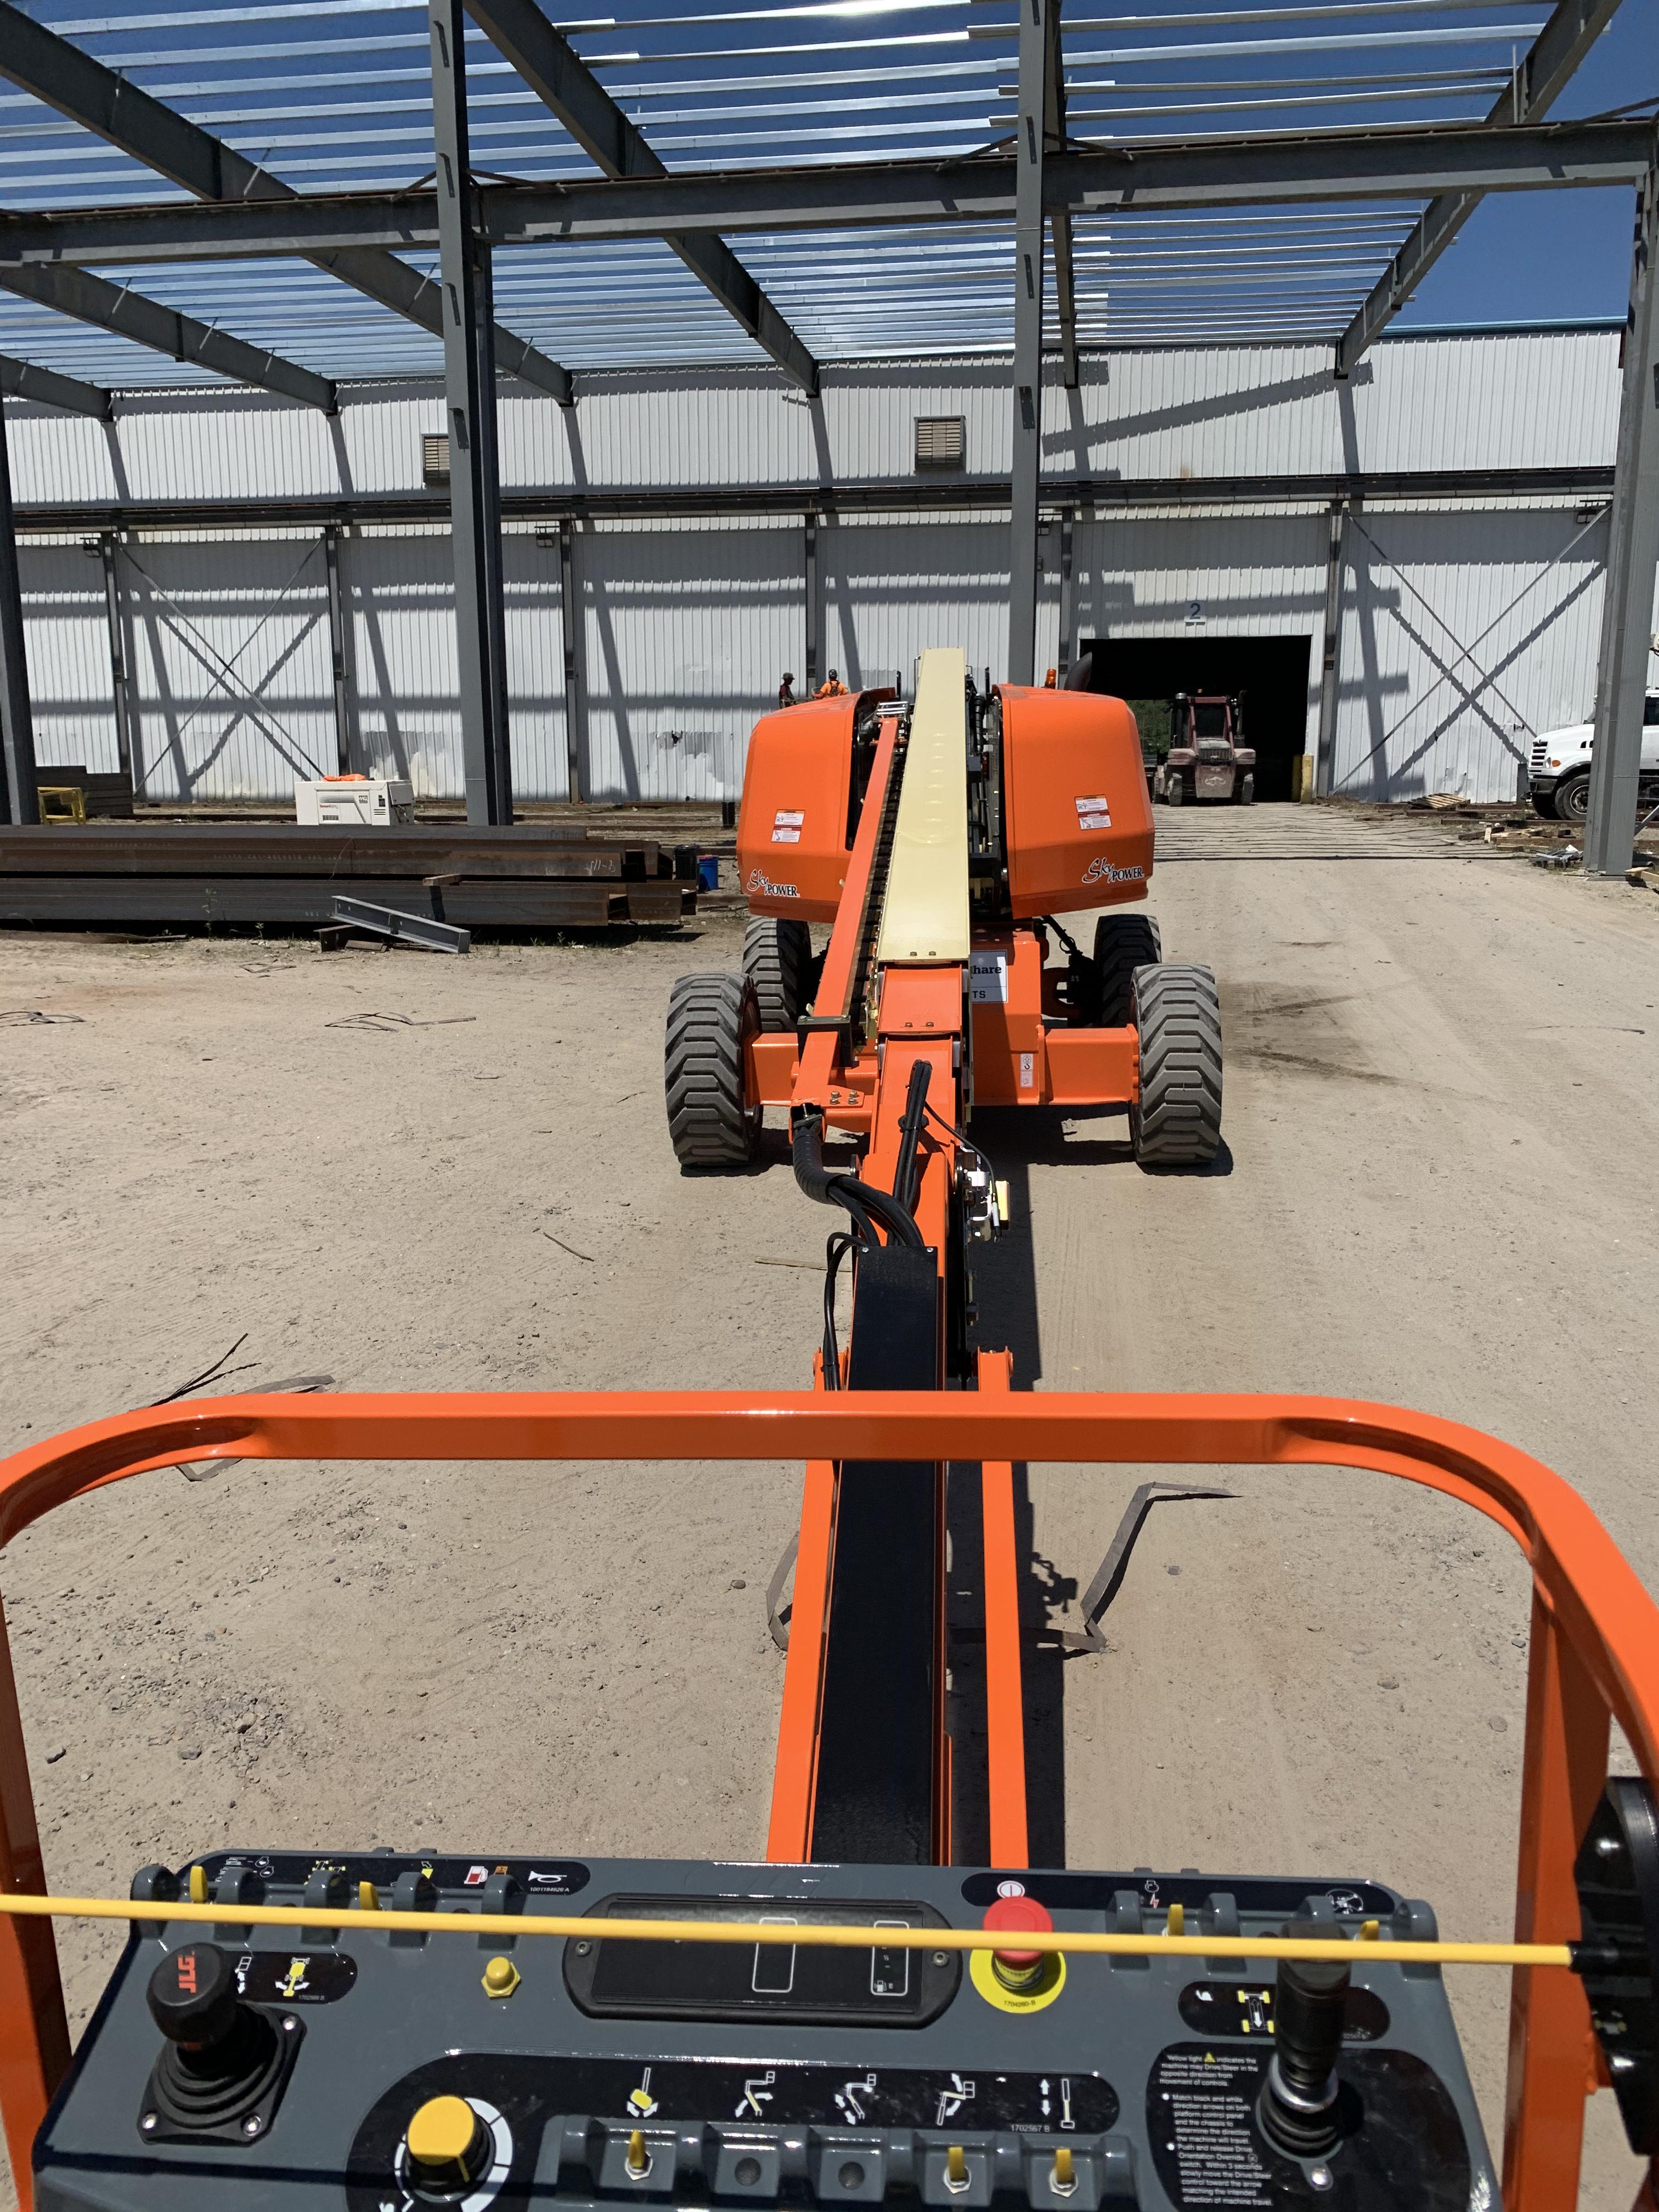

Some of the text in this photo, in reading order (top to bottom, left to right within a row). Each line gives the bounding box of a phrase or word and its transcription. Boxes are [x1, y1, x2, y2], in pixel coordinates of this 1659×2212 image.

[1189, 602, 1201, 620] 2
[747, 869, 797, 896] Sky POWER
[1081, 856, 1143, 884] Sky POWER
[178, 1954, 196, 1994] JLG
